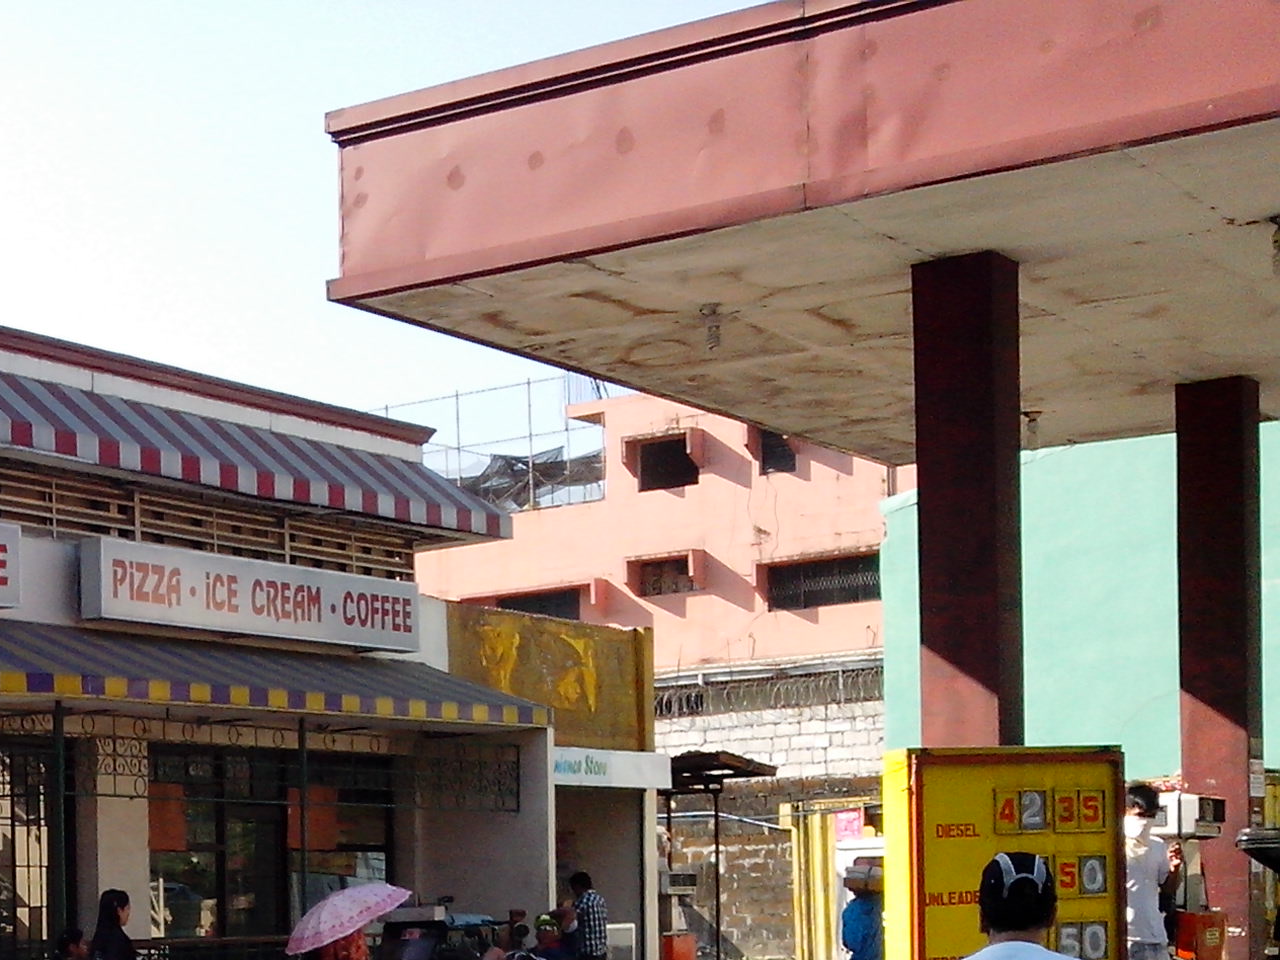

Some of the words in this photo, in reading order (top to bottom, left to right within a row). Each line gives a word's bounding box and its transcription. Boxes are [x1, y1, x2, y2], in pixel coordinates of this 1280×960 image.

[251, 578, 322, 623] CREAM
[342, 591, 412, 634] COFFEE
[936, 824, 980, 838] DIESEL
